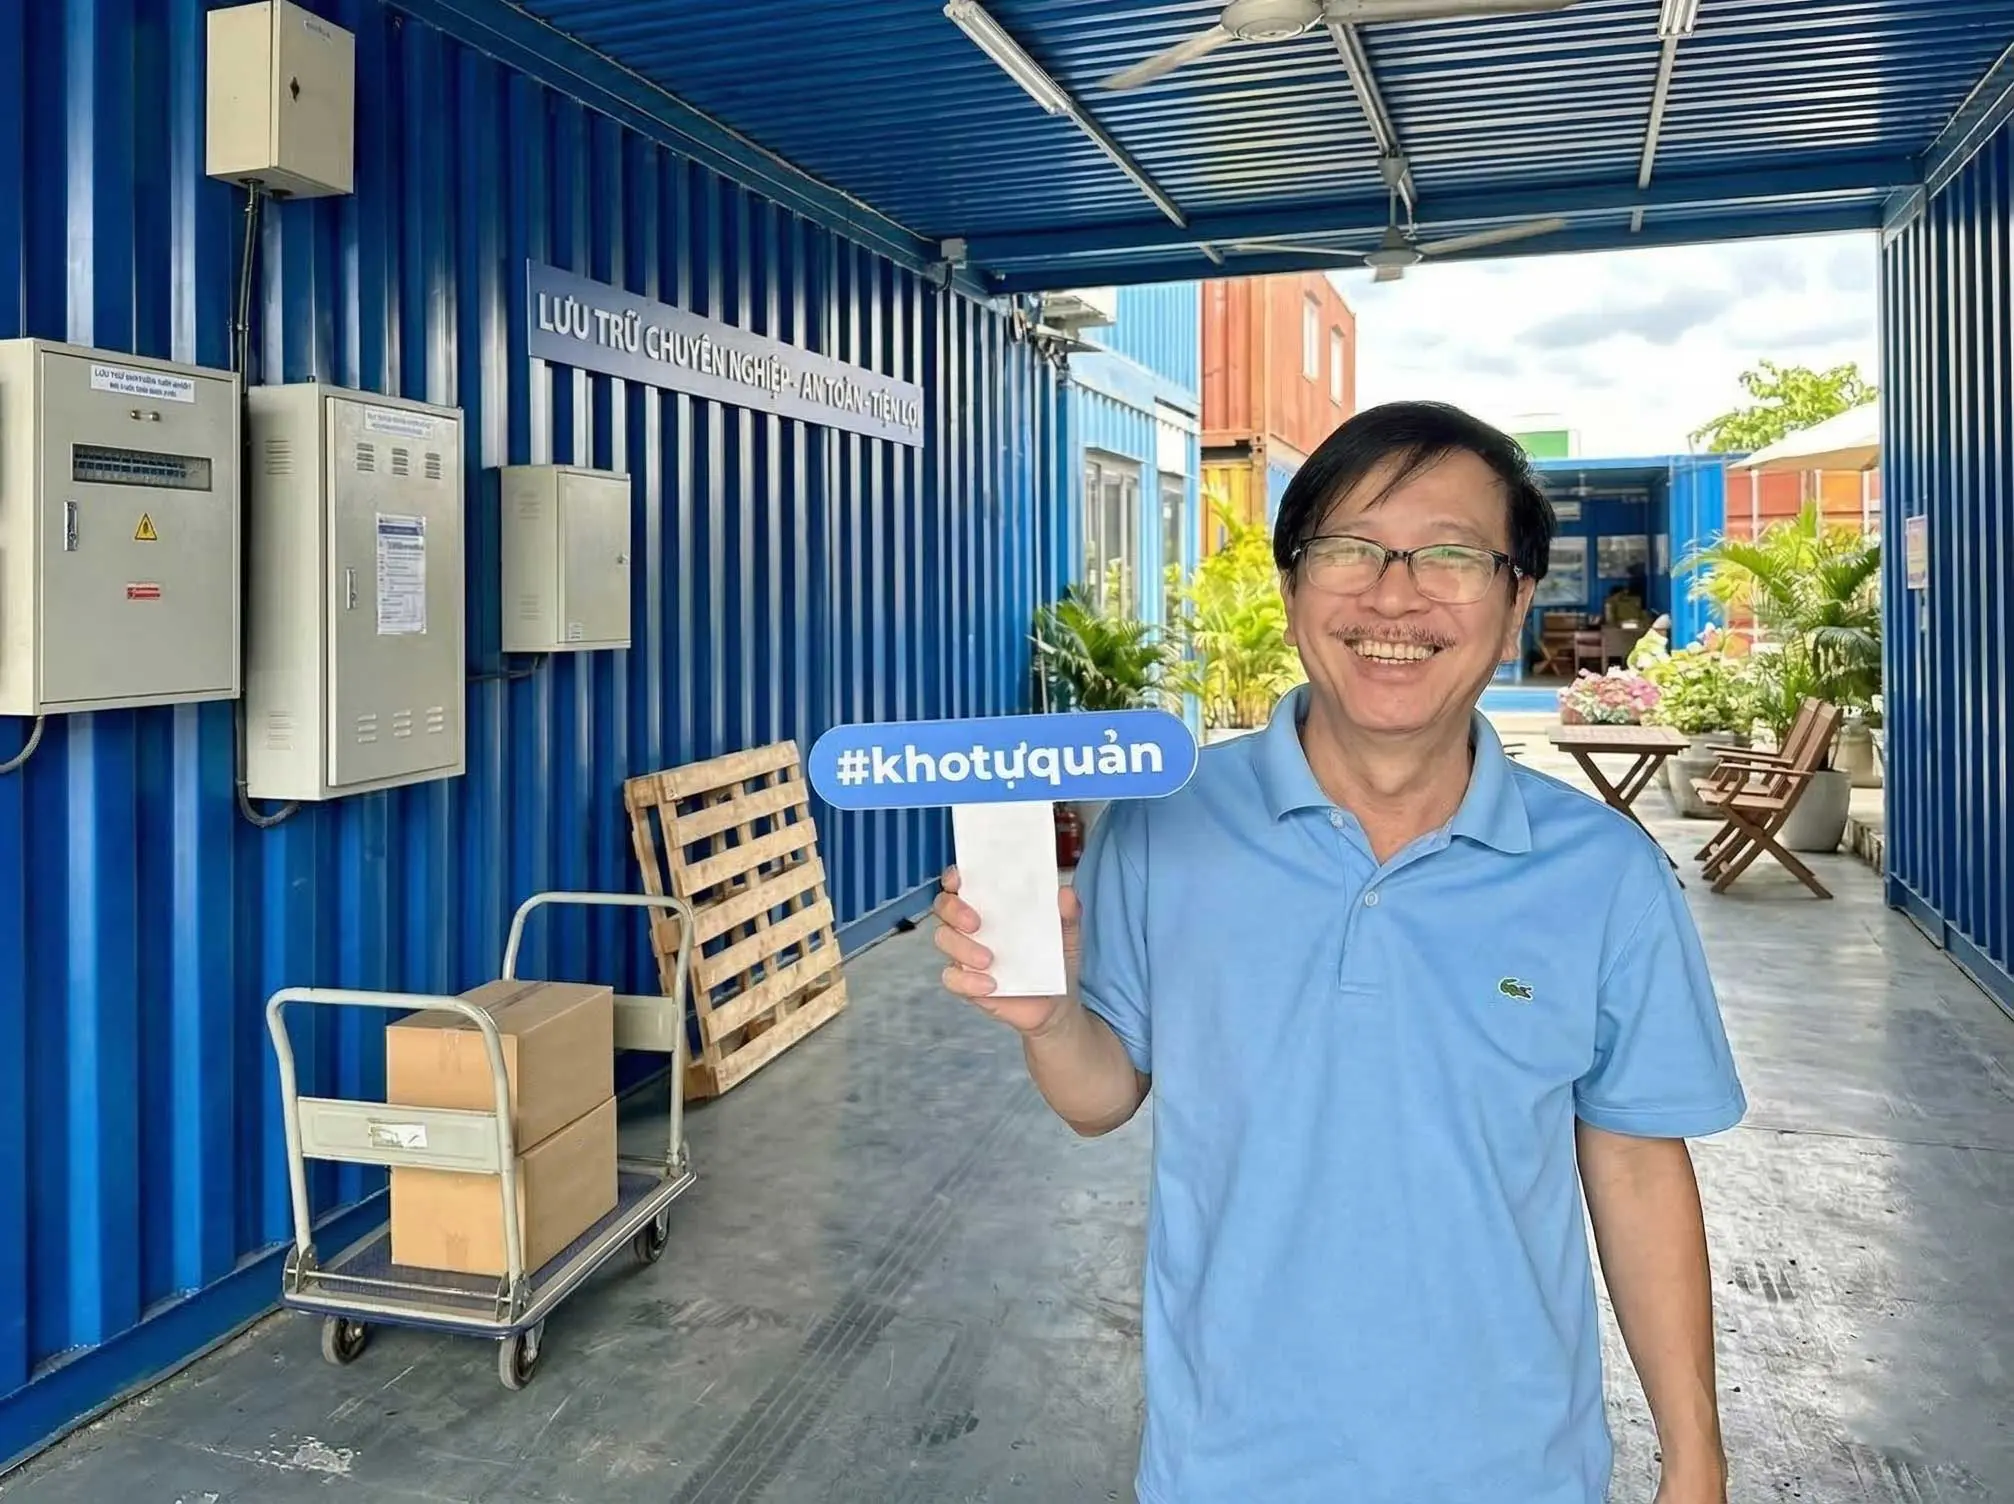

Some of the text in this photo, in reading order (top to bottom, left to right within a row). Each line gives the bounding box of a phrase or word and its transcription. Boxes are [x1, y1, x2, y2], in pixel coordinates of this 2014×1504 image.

[539, 291, 590, 341] LƯU
[594, 308, 642, 353] TRỮ
[646, 326, 725, 377] CHUYÊN
[728, 349, 790, 399] NGHIỆP
[801, 371, 822, 401] AN
[824, 375, 863, 414] TOÀN
[870, 387, 899, 427] TIỆN
[837, 729, 1163, 789] #khotựquản
